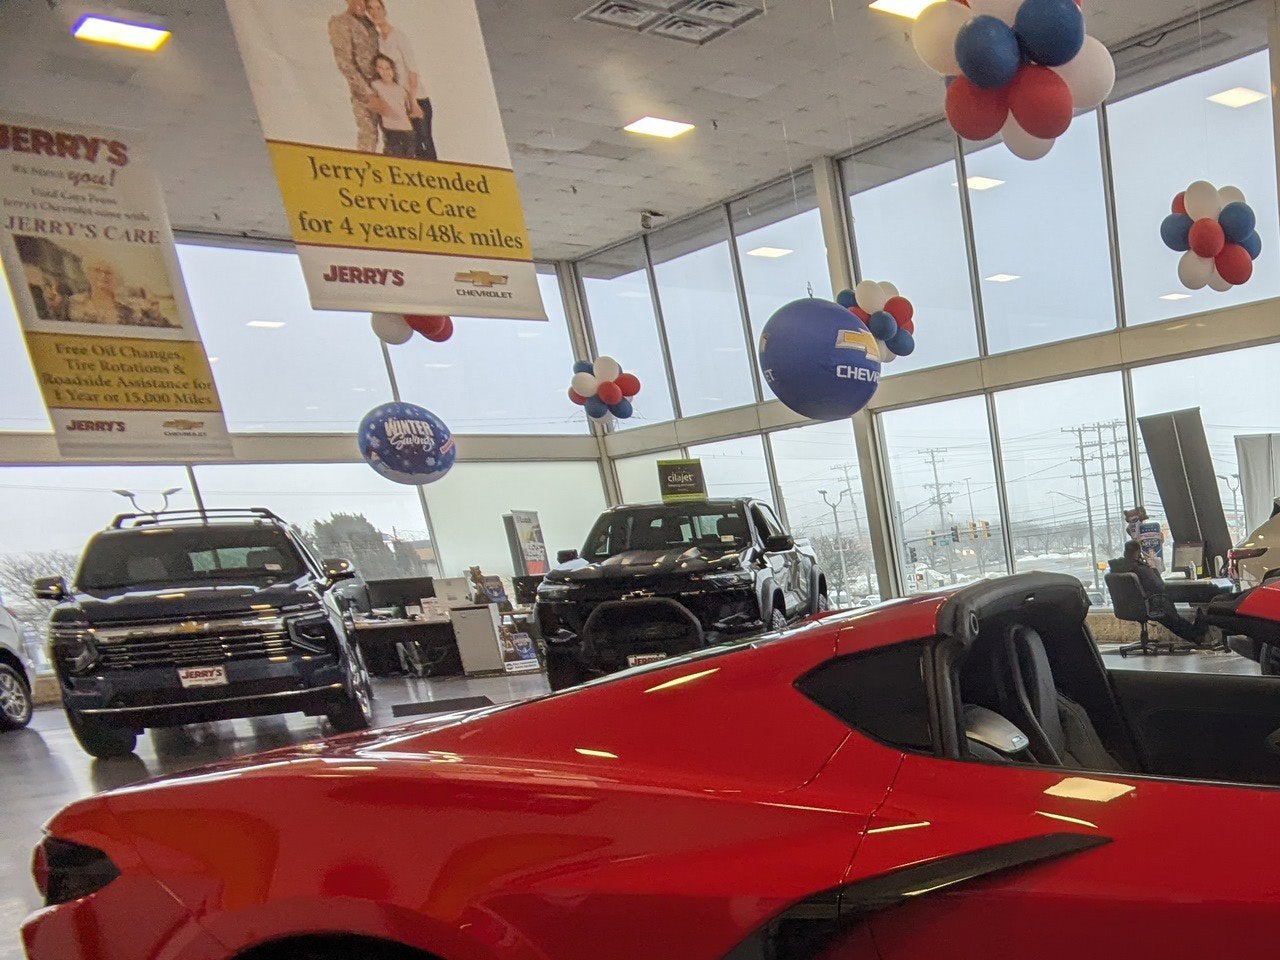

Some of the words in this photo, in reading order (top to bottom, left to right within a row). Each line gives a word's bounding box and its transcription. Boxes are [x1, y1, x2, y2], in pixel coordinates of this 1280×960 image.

[307, 156, 383, 187] Jerry's
[387, 165, 490, 194] Extended
[338, 188, 421, 214] Service
[426, 197, 477, 219] Care
[5, 215, 97, 239] JERRY'S
[103, 225, 161, 243] CARE
[298, 211, 333, 234] for
[340, 217, 353, 235] 4
[359, 221, 465, 244] years/48k
[470, 228, 523, 249] miles
[322, 265, 404, 287] JERRY'S
[456, 289, 513, 299] CHEVROLET
[55, 343, 87, 355] Free
[92, 344, 116, 357] Oil
[119, 346, 185, 362] Changes,
[64, 359, 95, 371] Tire
[99, 361, 169, 374] Rotations
[173, 365, 185, 375] &
[42, 372, 111, 387] Roadside
[117, 377, 189, 390] Assistance
[193, 377, 211, 390] for
[64, 389, 99, 402] Year
[104, 394, 118, 403] or
[124, 392, 170, 404] 15,000
[174, 393, 212, 405] Miles
[66, 419, 126, 432] JERRY'S
[384, 417, 434, 437] WINTER
[389, 433, 435, 453] Savings
[182, 669, 222, 679] JERRY'S
